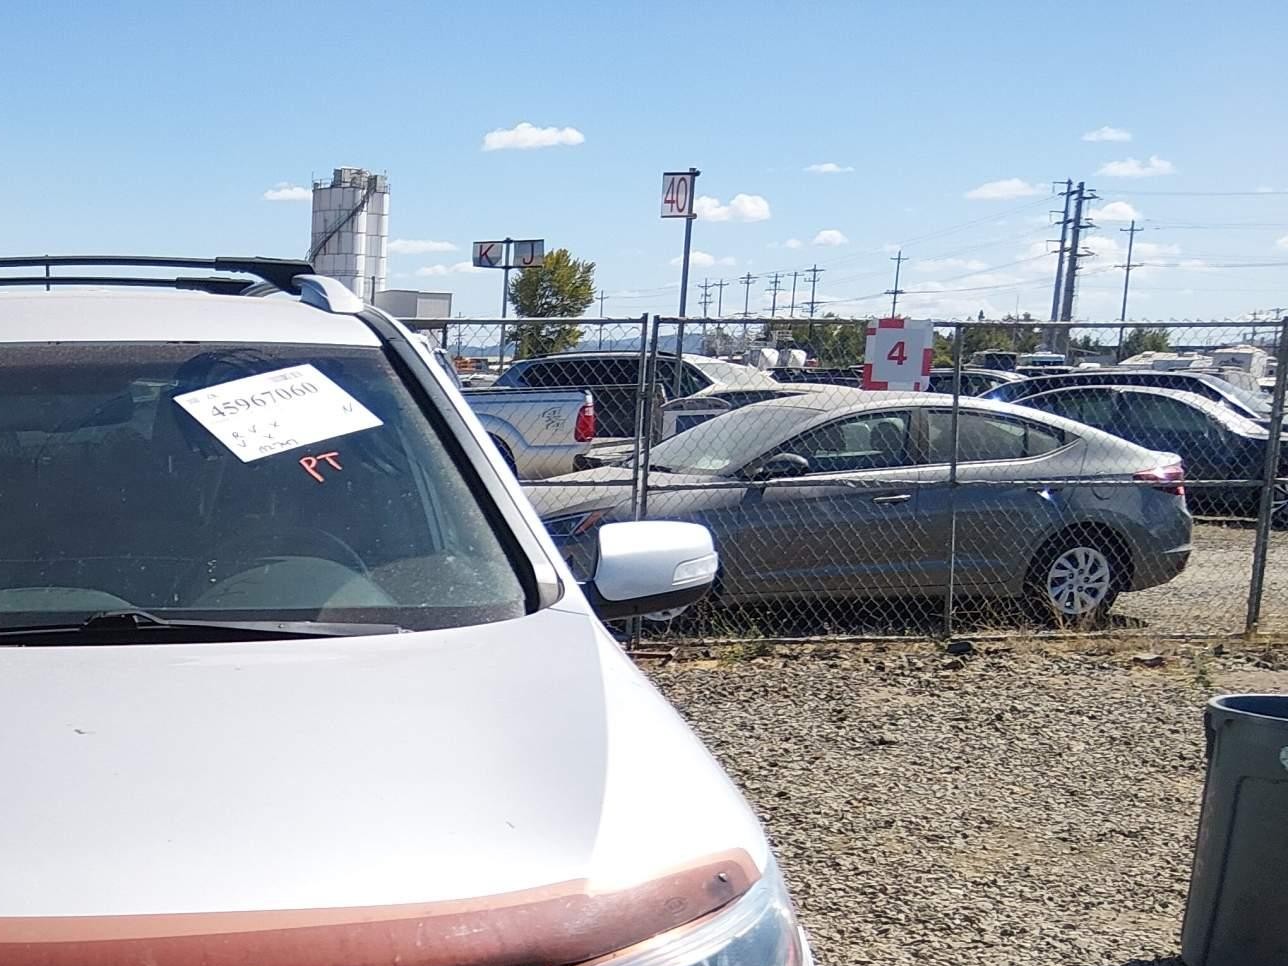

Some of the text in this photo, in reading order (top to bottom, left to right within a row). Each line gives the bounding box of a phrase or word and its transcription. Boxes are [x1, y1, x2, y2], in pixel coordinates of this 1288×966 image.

[664, 177, 688, 213] 40
[478, 243, 535, 266] K J
[887, 341, 908, 365] 4
[211, 382, 320, 418] 45967060
[299, 451, 343, 483] PT
